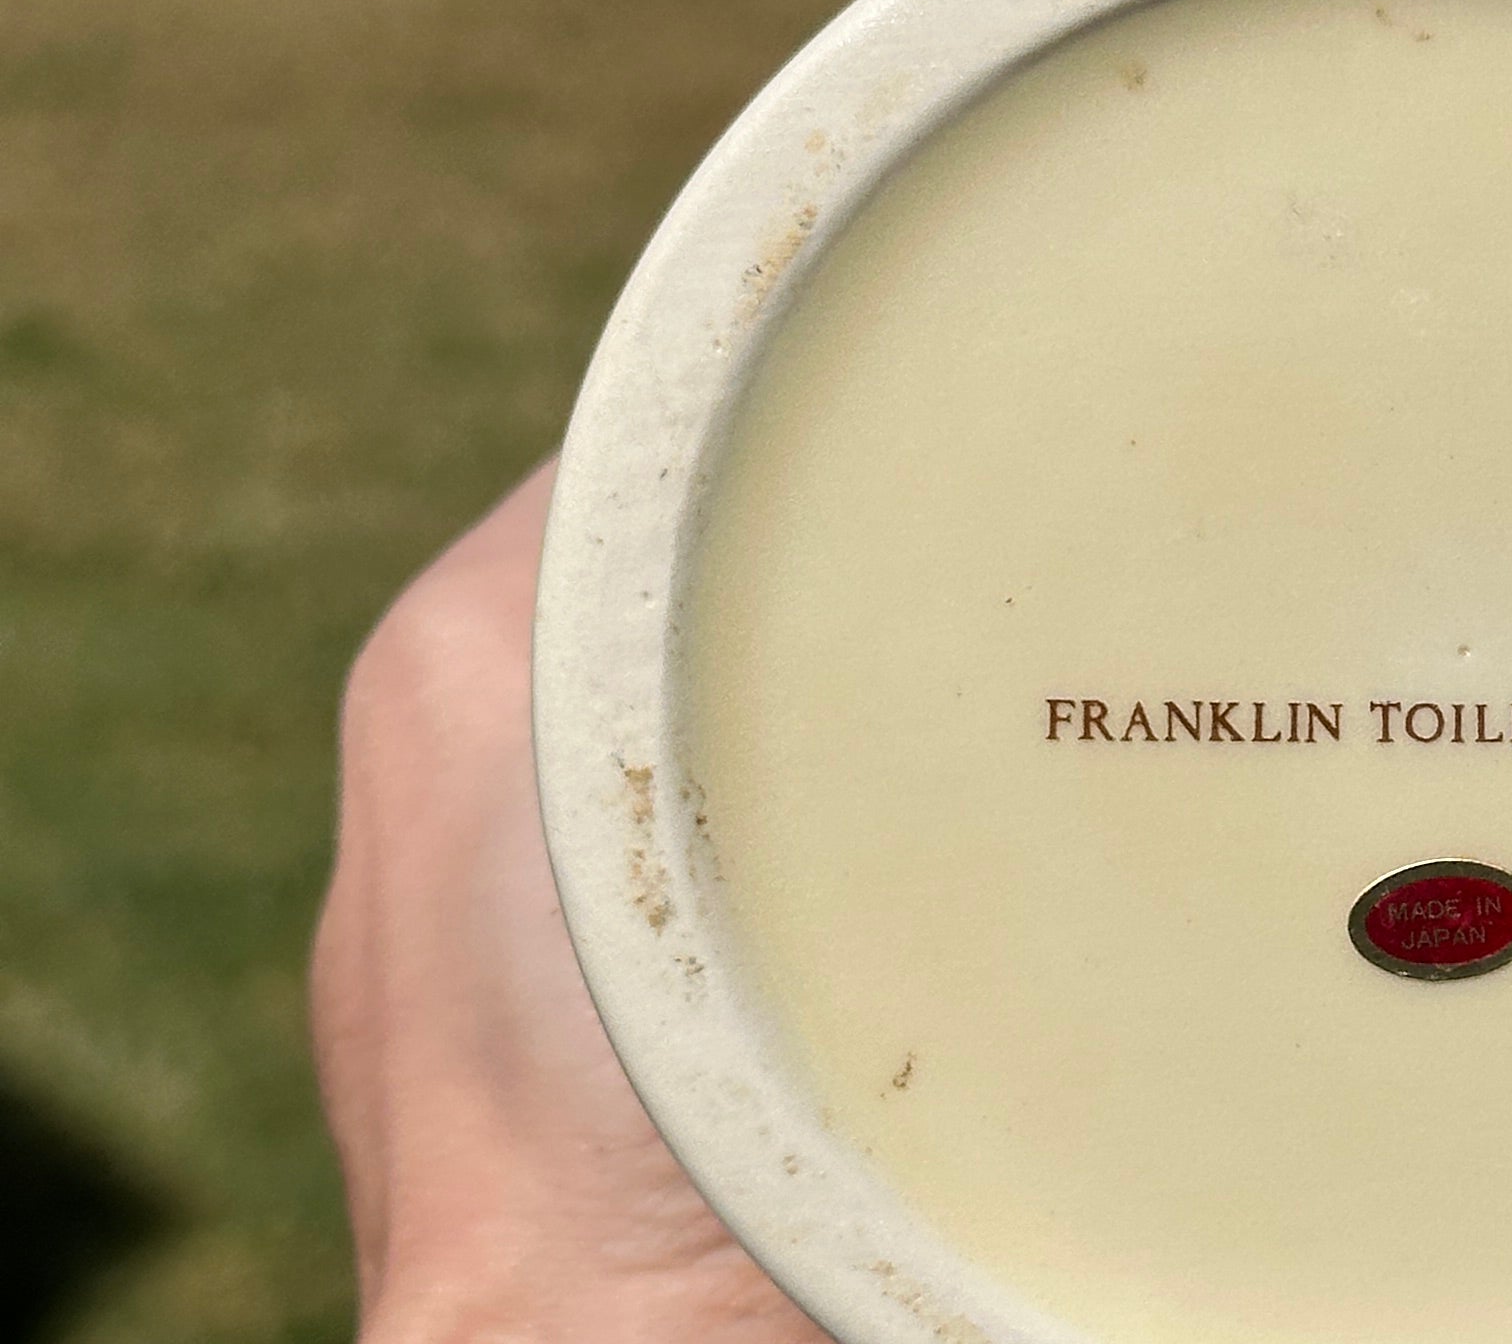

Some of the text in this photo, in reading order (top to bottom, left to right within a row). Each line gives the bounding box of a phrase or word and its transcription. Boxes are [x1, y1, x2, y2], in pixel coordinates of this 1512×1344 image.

[1043, 698, 1345, 745] FRANKLIN
[1388, 895, 1502, 922] MADE IN
[1402, 927, 1486, 949] JAPAN
